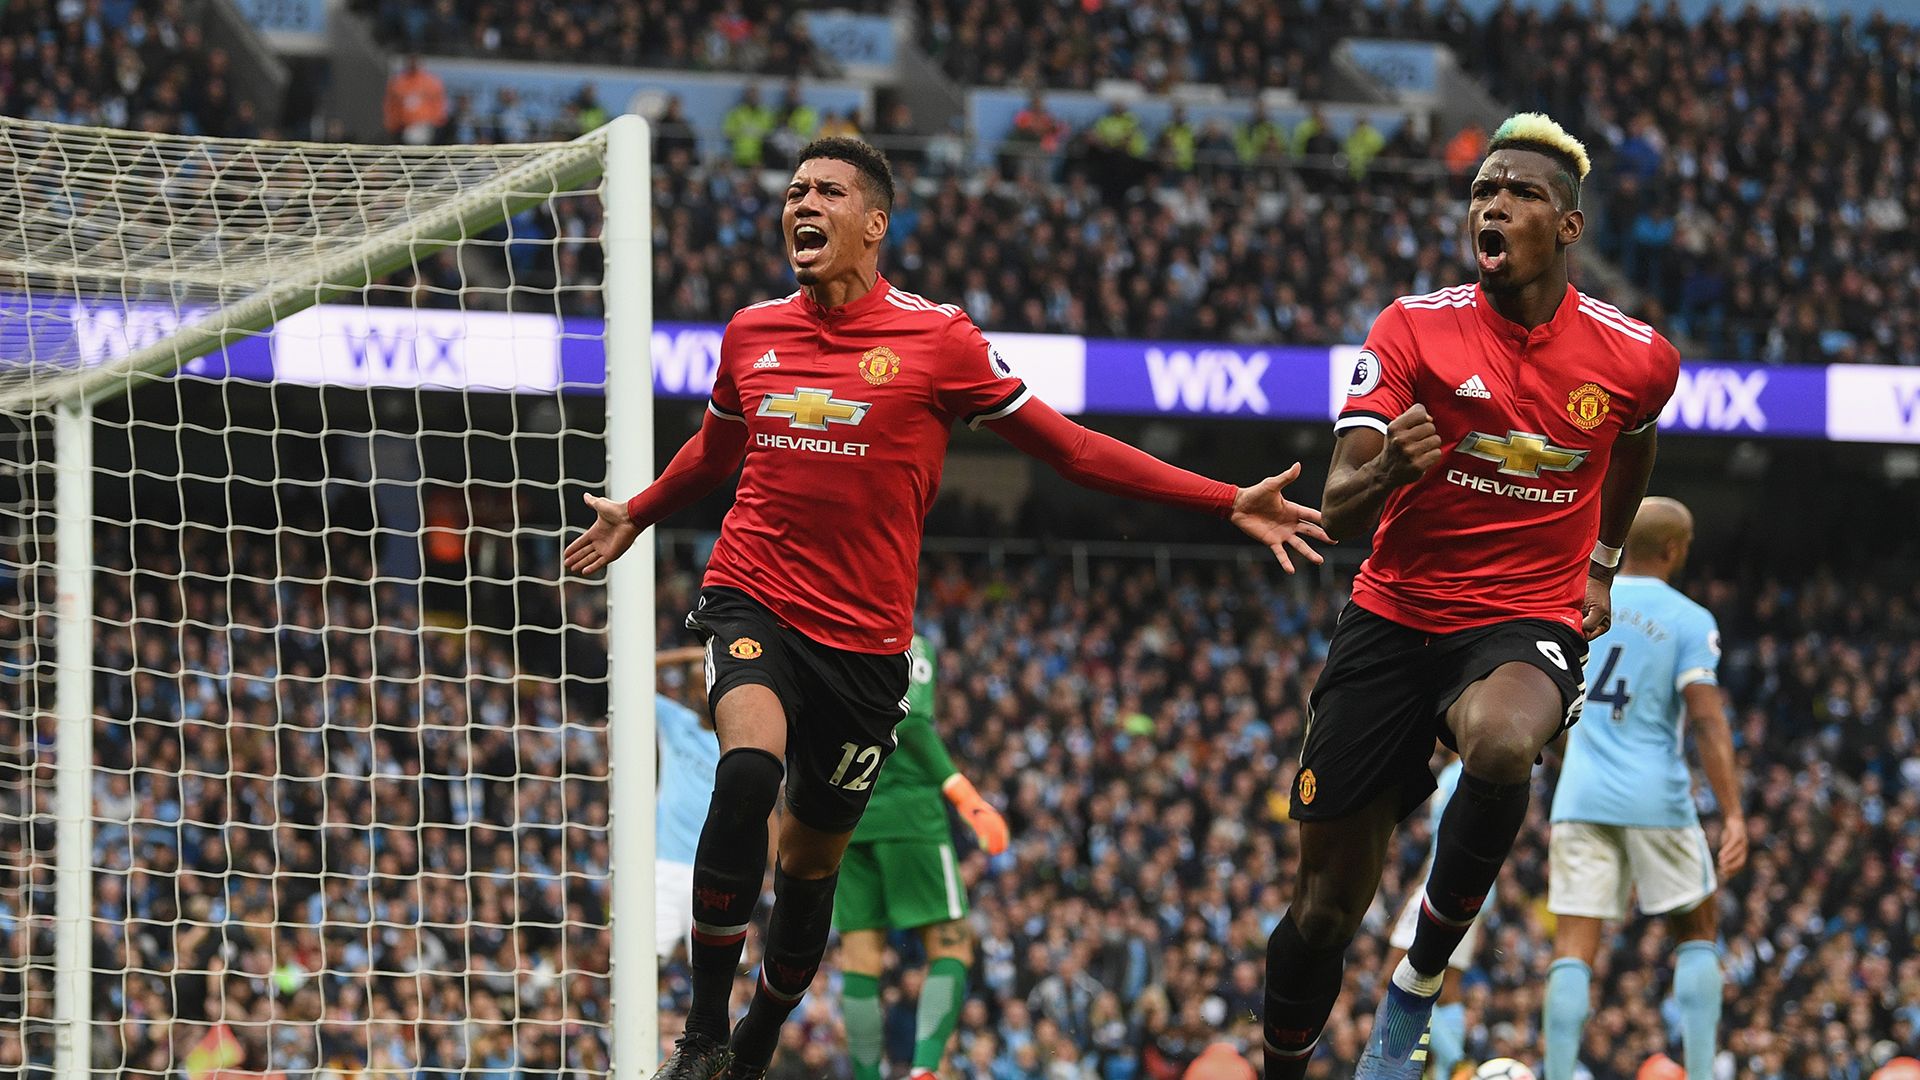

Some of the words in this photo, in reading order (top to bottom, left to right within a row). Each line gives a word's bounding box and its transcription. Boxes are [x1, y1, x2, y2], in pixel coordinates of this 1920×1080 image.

[753, 361, 780, 369] adidas
[1455, 387, 1491, 399] adidas
[1571, 386, 1607, 402] MANCHESTER
[1576, 417, 1600, 426] UNITED
[755, 433, 870, 456] CHEVROLET
[1446, 469, 1578, 503] CHEVROLET
[1587, 646, 1631, 721] 4
[829, 741, 882, 791] 12
